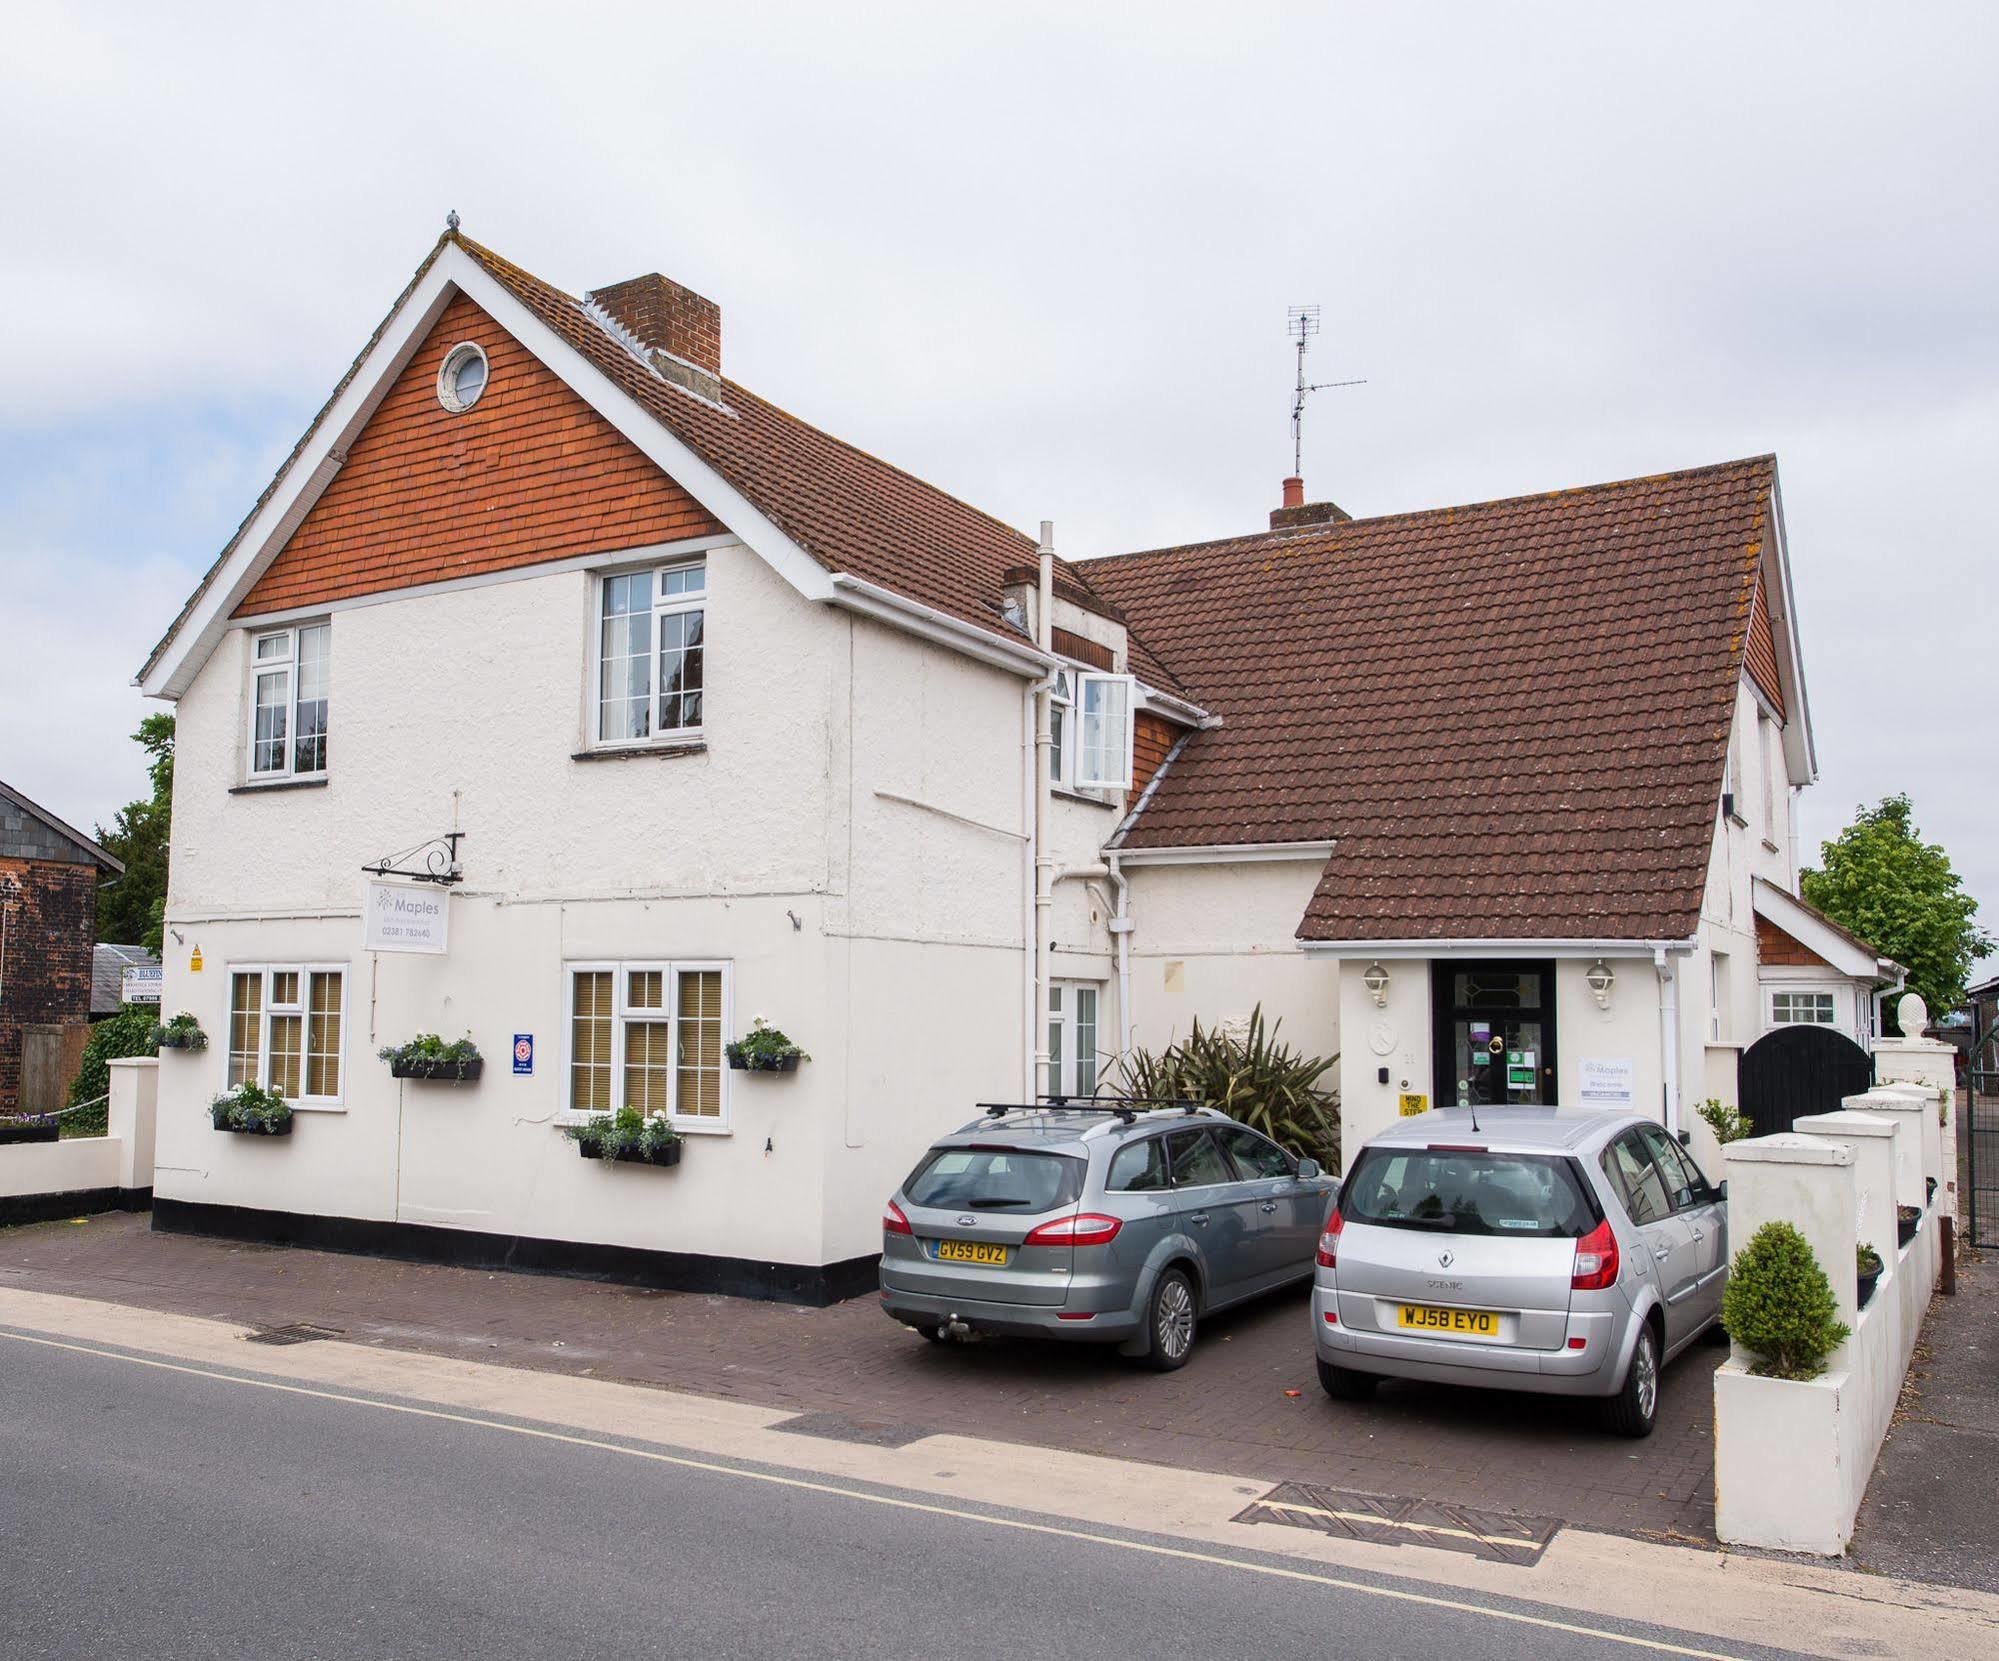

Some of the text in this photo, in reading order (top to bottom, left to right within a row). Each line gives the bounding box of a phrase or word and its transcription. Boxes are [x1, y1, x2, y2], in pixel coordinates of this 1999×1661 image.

[394, 898, 440, 915] Maples
[382, 926, 403, 936] 02381
[1596, 1066, 1629, 1074] Maples
[940, 1241, 1003, 1262] GV59 GVZ
[1426, 1280, 1464, 1290] SCENIC
[1405, 1308, 1490, 1331] WJ58 EYO
